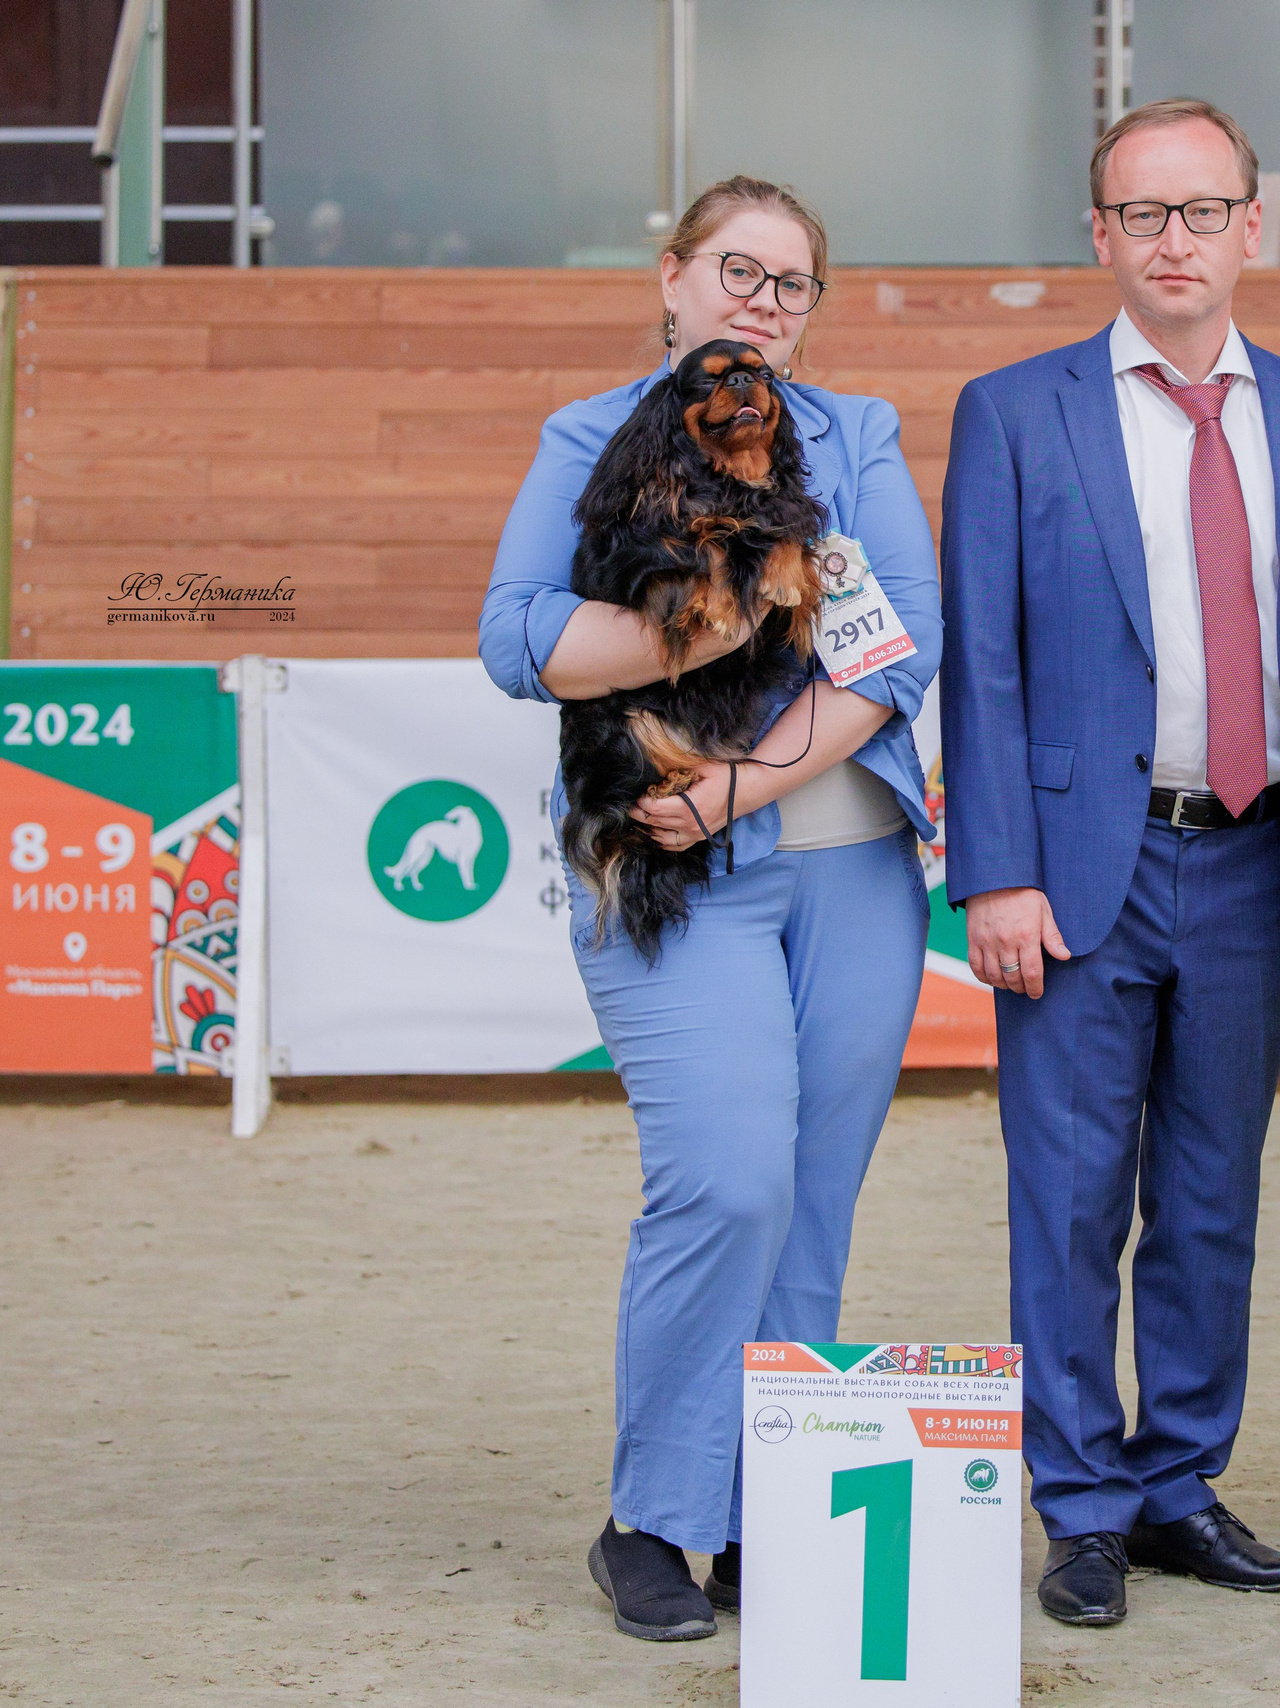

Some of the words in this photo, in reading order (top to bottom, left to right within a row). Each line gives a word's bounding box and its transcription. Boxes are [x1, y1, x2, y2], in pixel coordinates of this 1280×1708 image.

[824, 607, 885, 653] 2917
[868, 639, 907, 663] 9.06.2024
[2, 702, 135, 746] 2024
[9, 822, 49, 873] 8
[95, 822, 136, 873] 9
[12, 882, 137, 913] ИЮНЯ
[751, 1349, 786, 1362] 2024
[751, 1375, 841, 1386] НАЦИОНАЛЬНЫЕ
[844, 1378, 901, 1388] ВЫСТАВКИ
[904, 1379, 939, 1389] СОБАК
[943, 1380, 969, 1389] ВСЕХ
[973, 1381, 1010, 1391] ПОРОД
[758, 1388, 848, 1399] НАЦИОНАЛЬНЫЕ
[851, 1390, 942, 1401] МОНОПОРОДНЫЕ
[945, 1393, 1002, 1402] ВЫСТАВКИ
[802, 1412, 885, 1437] Champion
[925, 1417, 951, 1429] 8-9
[956, 1418, 1009, 1431] ИЮНЯ
[853, 1434, 881, 1442] NATURE
[924, 1432, 979, 1442] МАКСИМА
[980, 1433, 1008, 1443] ПАРК
[960, 1496, 1002, 1505] РОССИЯ
[830, 1458, 913, 1681] 1
